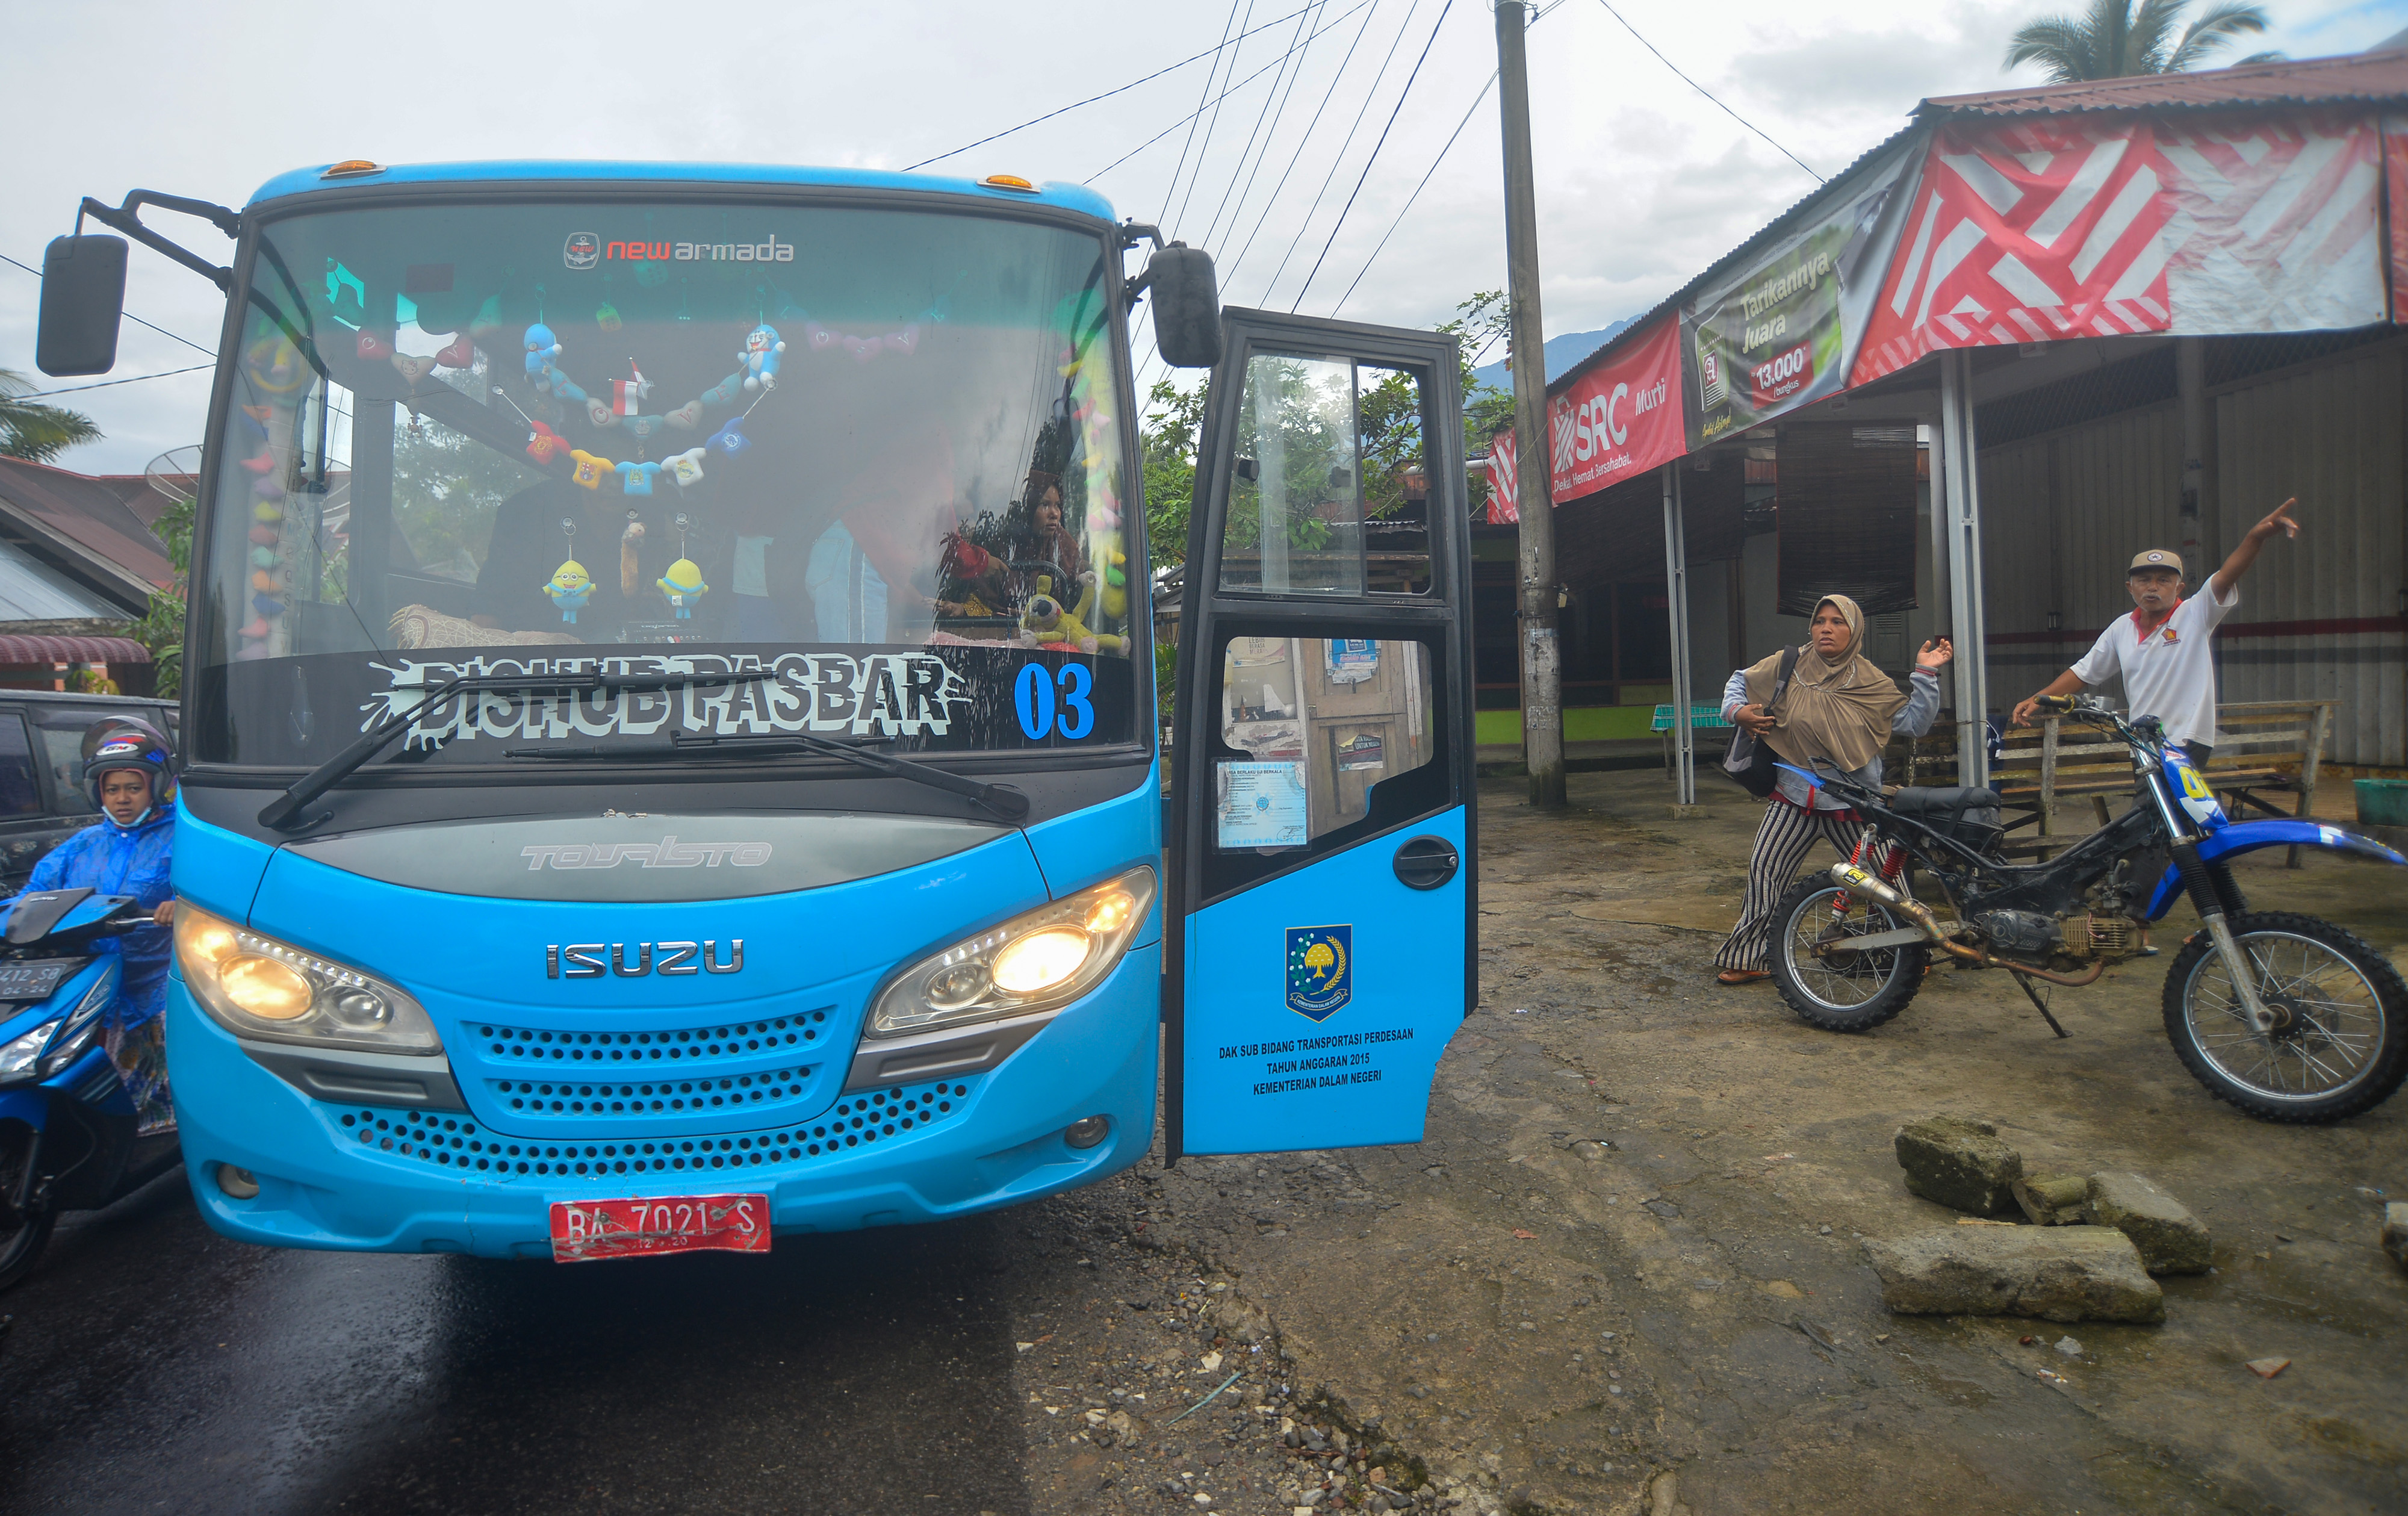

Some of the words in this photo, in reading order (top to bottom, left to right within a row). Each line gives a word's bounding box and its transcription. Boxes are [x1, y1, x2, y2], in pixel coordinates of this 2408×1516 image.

[607, 241, 670, 260] new
[675, 234, 793, 262] armada
[1740, 252, 1830, 322] Tarikannya
[1742, 314, 1786, 354] Juara
[1576, 382, 1628, 461] SRC
[1635, 378, 1666, 416] Murti
[670, 654, 951, 736] PASBAR
[1015, 663, 1094, 741] 03
[547, 939, 743, 979] ISUZU
[1297, 999, 1318, 1008] KEMENTERIAN
[1329, 995, 1341, 1005] NEGERI
[1219, 1046, 1238, 1059] DAK
[1240, 1043, 1259, 1057] SUB
[1261, 1040, 1295, 1055] BIDANG
[1297, 1033, 1362, 1051] TRANSPORTASI
[1364, 1028, 1413, 1044] PERDESAAN
[1267, 1061, 1297, 1075] TAHUN
[1300, 1055, 1348, 1072] ANGGARAN
[1350, 1052, 1370, 1065] 2015
[1253, 1077, 1317, 1095] KEMENTERIAN
[1319, 1073, 1348, 1088] DALAM
[1350, 1069, 1382, 1084] NEGERI
[567, 1208, 606, 1246] BA
[631, 1202, 709, 1239] 7021
[736, 1201, 755, 1234] S
